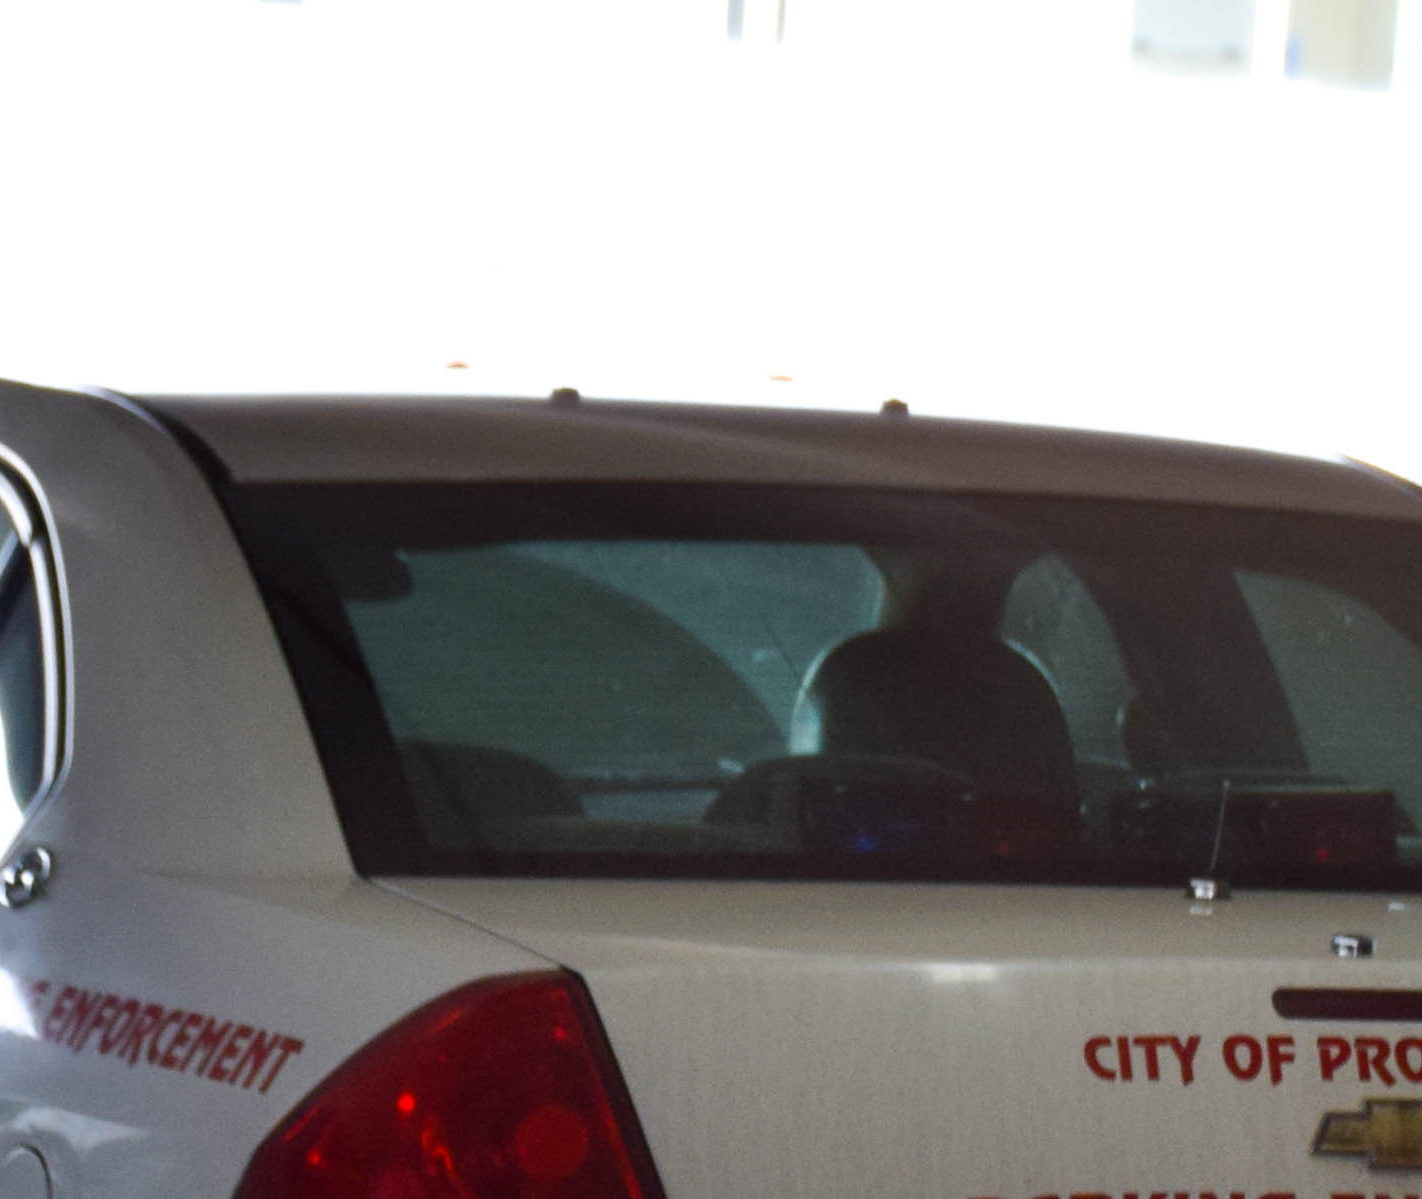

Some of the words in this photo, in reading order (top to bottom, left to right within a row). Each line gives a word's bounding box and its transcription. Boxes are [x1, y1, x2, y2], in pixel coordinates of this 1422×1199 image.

[42, 985, 305, 1095] ENFORCEMENT
[1083, 1035, 1201, 1086] CITY
[1222, 1035, 1296, 1086] OF
